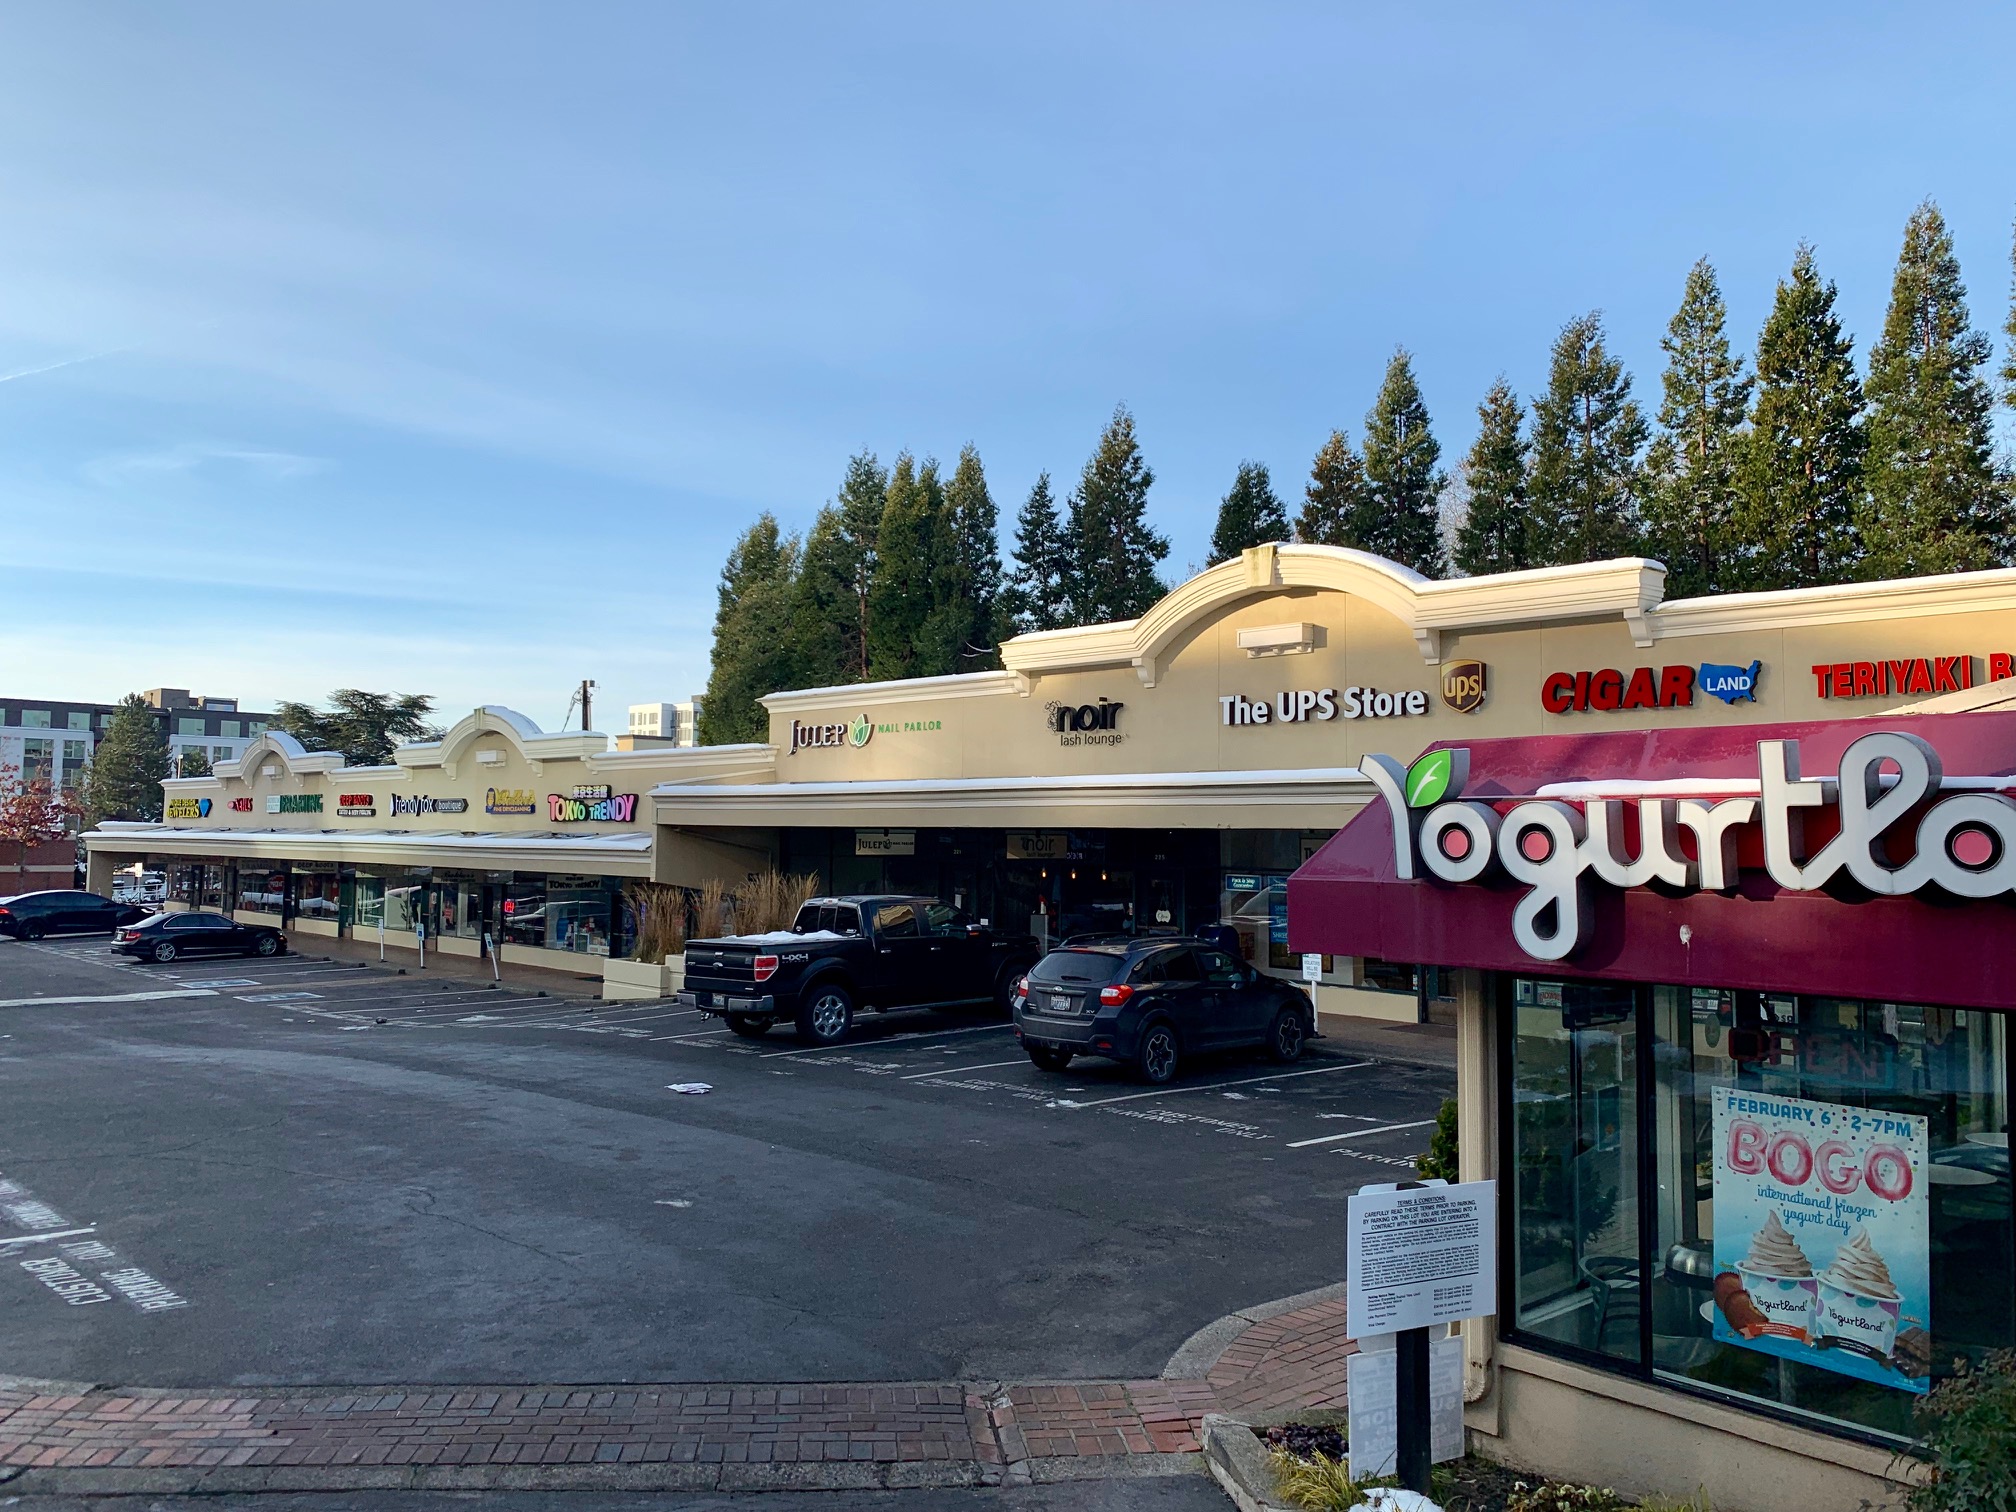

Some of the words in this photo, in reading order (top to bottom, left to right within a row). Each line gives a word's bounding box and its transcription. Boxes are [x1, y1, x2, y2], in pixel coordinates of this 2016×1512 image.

[1706, 676, 1751, 692] LAND
[1812, 655, 1971, 698] TERIYAKI
[1443, 675, 1480, 705] ups
[1542, 665, 1695, 713] CIGAR
[1056, 697, 1124, 732] noir
[1219, 695, 1270, 725] The
[1277, 688, 1336, 722] UPS
[1344, 686, 1428, 719] Store
[878, 724, 900, 734] NAIL
[904, 720, 942, 732] PARLOR
[1060, 734, 1081, 746] lash
[1084, 733, 1122, 746] lounge
[396, 795, 421, 817] trendy
[420, 795, 434, 813] fox
[438, 802, 462, 812] boutique
[548, 795, 587, 822] TOKYO
[589, 796, 637, 822] TRENDY
[1023, 836, 1055, 851] noir
[782, 953, 809, 961] 4X4
[1146, 1109, 1260, 1130] CUSTOMER
[1727, 1096, 1813, 1122] FEBRUARY
[1825, 1111, 1837, 1125] 6
[1851, 1114, 1912, 1139] 2-7PM
[1215, 1127, 1276, 1139] ONLY
[1329, 1148, 1418, 1168] PARKIN
[1727, 1118, 1914, 1202] BOGO
[1757, 1184, 1833, 1211] international
[1835, 1197, 1879, 1223] frozen
[1371, 1216, 1390, 1224] PARKING
[1371, 1222, 1396, 1231] CONTRACT
[1418, 1217, 1438, 1225] PARKING
[1782, 1208, 1824, 1228] yogurt
[1826, 1212, 1852, 1236] day
[20, 1257, 112, 1305] CUSTOMER
[1754, 1294, 1807, 1313] Yogurtland
[1828, 1306, 1884, 1332] Yogurtland
